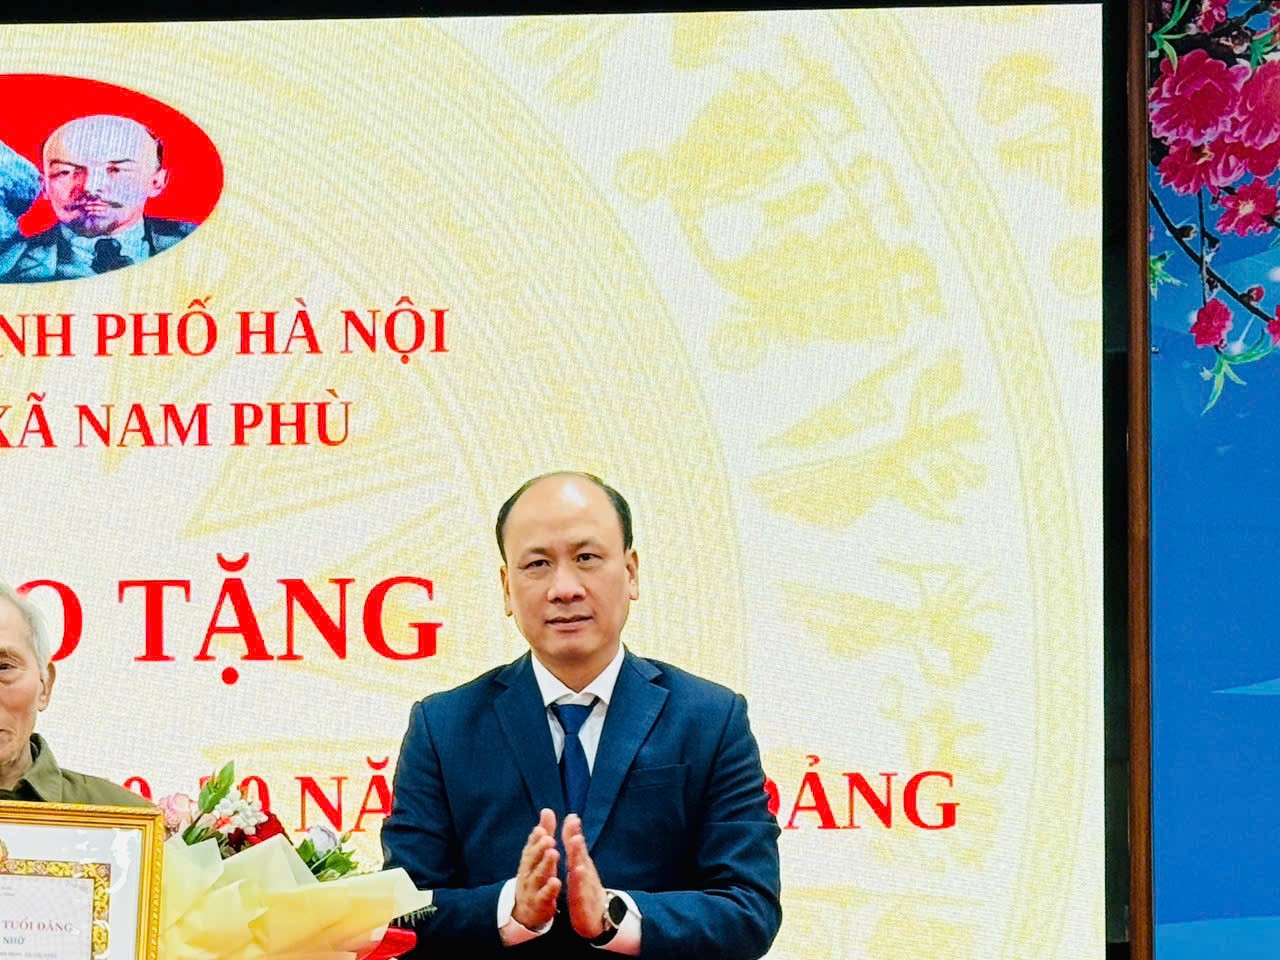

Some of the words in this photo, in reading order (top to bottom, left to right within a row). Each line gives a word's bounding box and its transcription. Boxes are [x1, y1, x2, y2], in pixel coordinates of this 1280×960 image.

[95, 298, 218, 357] PHỐ
[238, 299, 321, 356] HÀ
[342, 296, 448, 364] NỘI
[76, 403, 210, 448] NAM
[232, 390, 354, 447] PHÙ
[117, 553, 444, 686] TẶNG
[295, 756, 395, 832] NĂ
